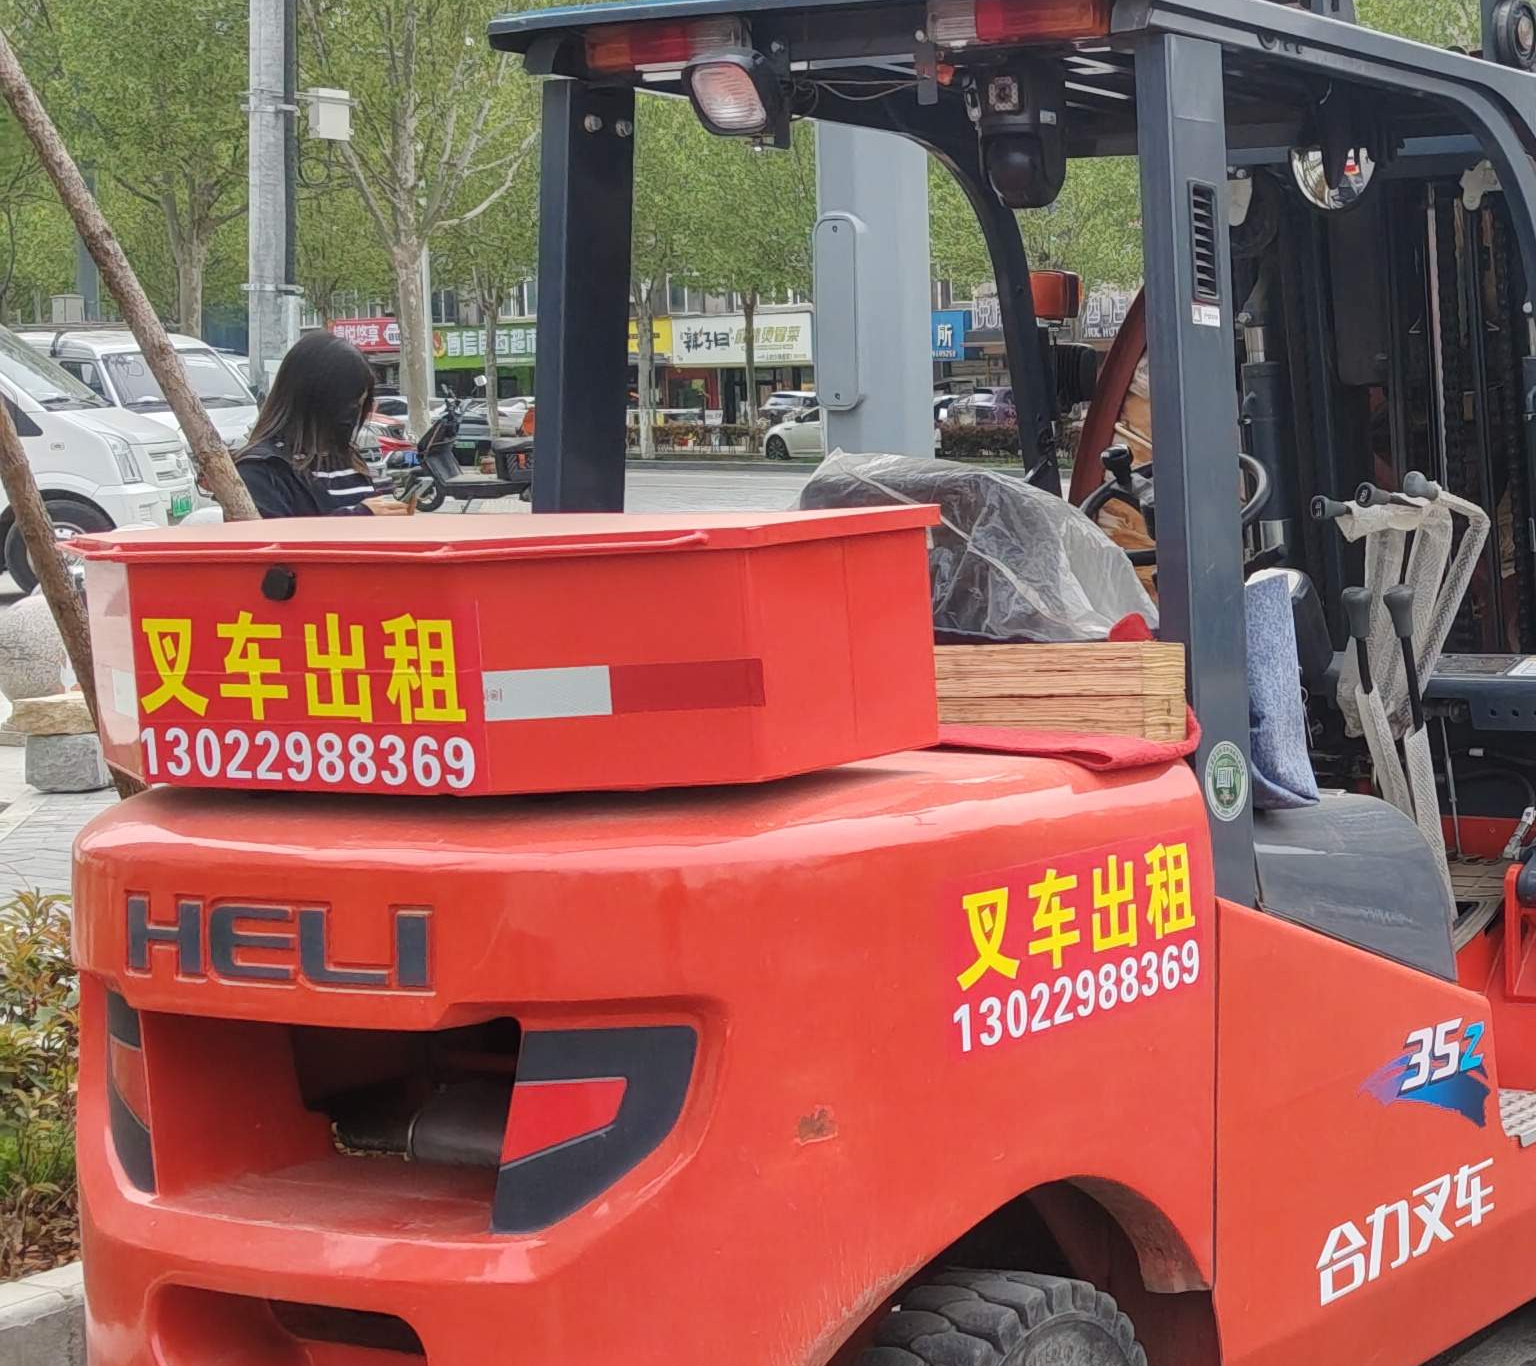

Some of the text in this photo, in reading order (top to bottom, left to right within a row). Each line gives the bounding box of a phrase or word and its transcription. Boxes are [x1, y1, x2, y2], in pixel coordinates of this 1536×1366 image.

[141, 611, 467, 724] 叉车出租
[140, 726, 476, 788] 13022988369
[127, 891, 432, 993] HELI
[956, 842, 1196, 991] 叉车出租
[953, 939, 1200, 1052] 13022988369
[1315, 1157, 1496, 1307] 合力叉车
